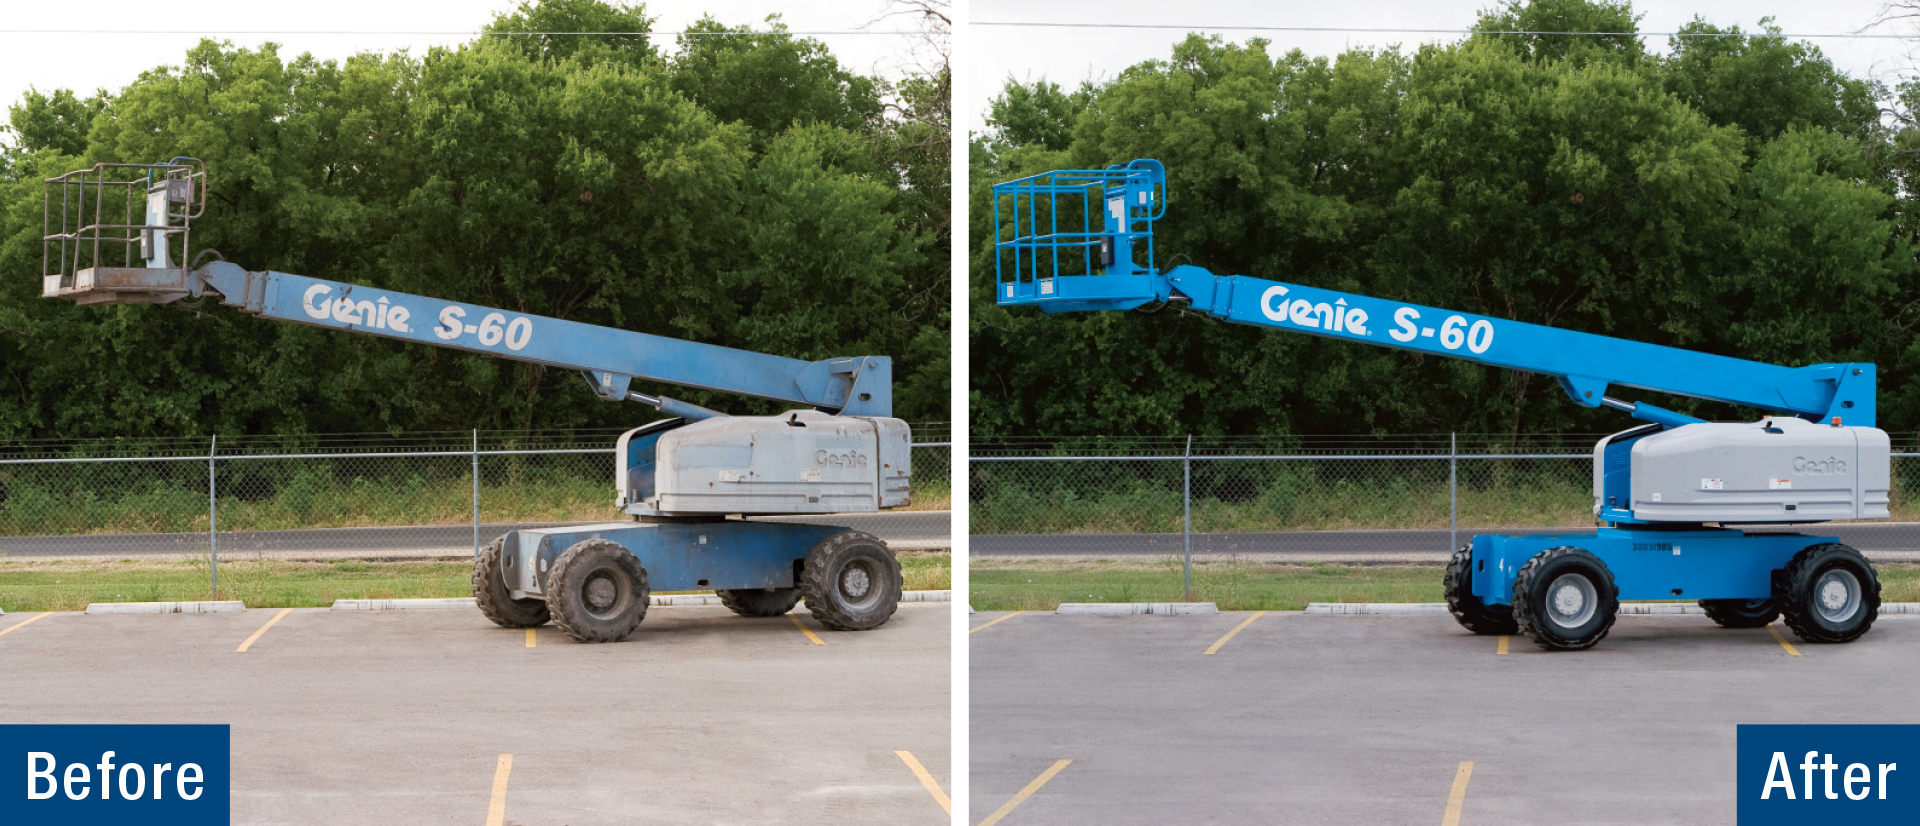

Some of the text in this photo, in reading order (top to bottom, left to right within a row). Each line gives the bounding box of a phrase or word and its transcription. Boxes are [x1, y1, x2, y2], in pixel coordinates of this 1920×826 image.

[303, 284, 533, 351] Genie S-60
[1260, 285, 1495, 354] Genie S-60
[814, 448, 868, 469] Genie
[1792, 456, 1847, 475] Genie
